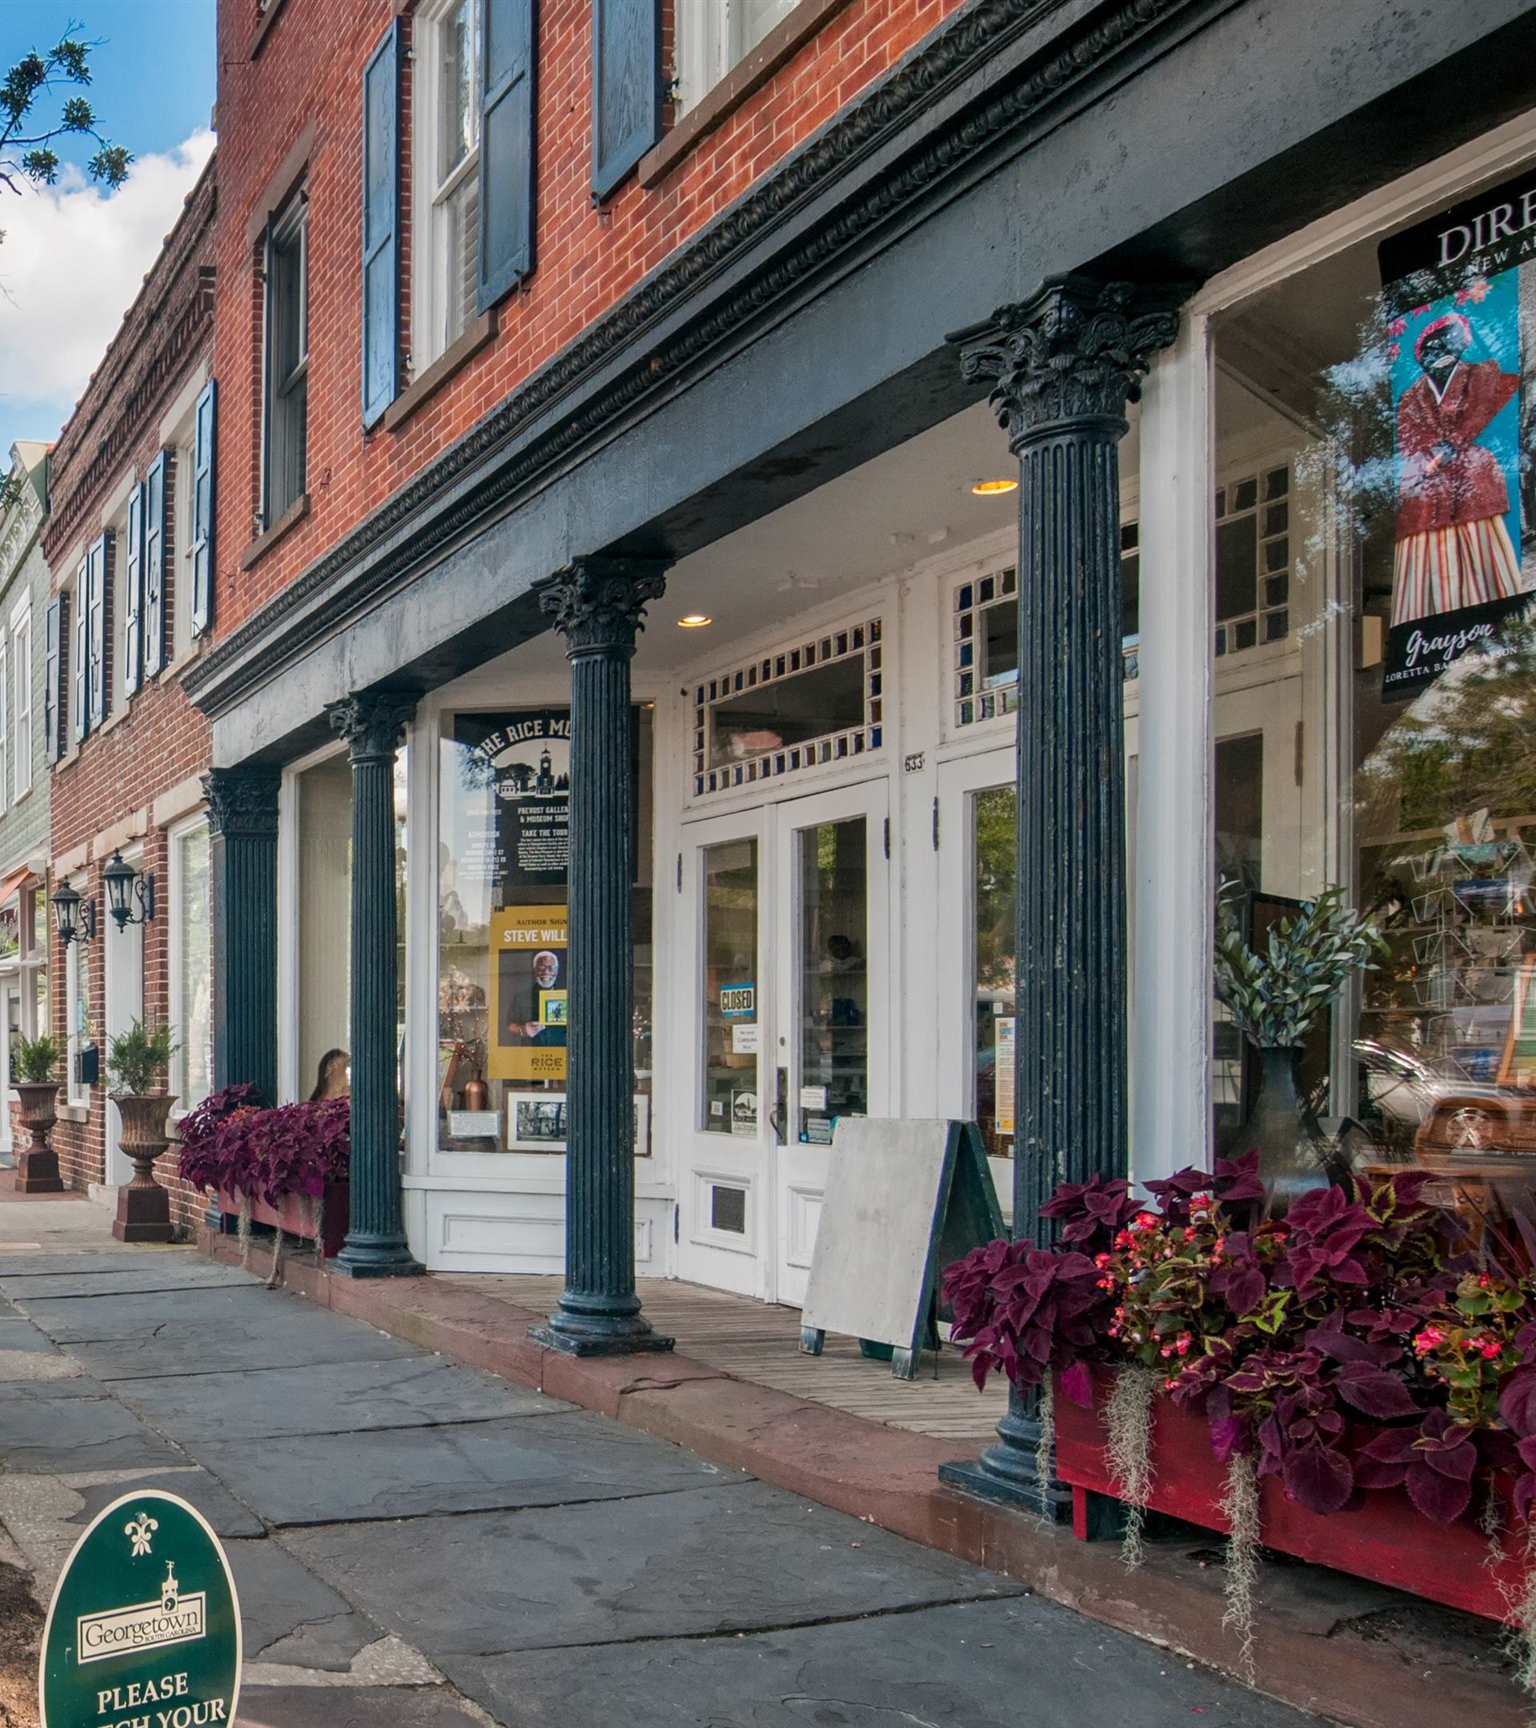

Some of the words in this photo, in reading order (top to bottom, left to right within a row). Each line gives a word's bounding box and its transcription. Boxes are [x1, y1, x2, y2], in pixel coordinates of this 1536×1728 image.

[1405, 624, 1494, 667] Grayson
[1385, 666, 1430, 683] LORETTA
[506, 721, 543, 742] RICE
[504, 929, 539, 943] STEVE
[721, 990, 752, 1010] CLOSED
[531, 1058, 563, 1067] RICE
[85, 1611, 198, 1647] Georgetown
[166, 1627, 196, 1640] CAROLINA
[97, 1672, 189, 1714] PLEASE
[156, 1698, 227, 1728] YOUR
